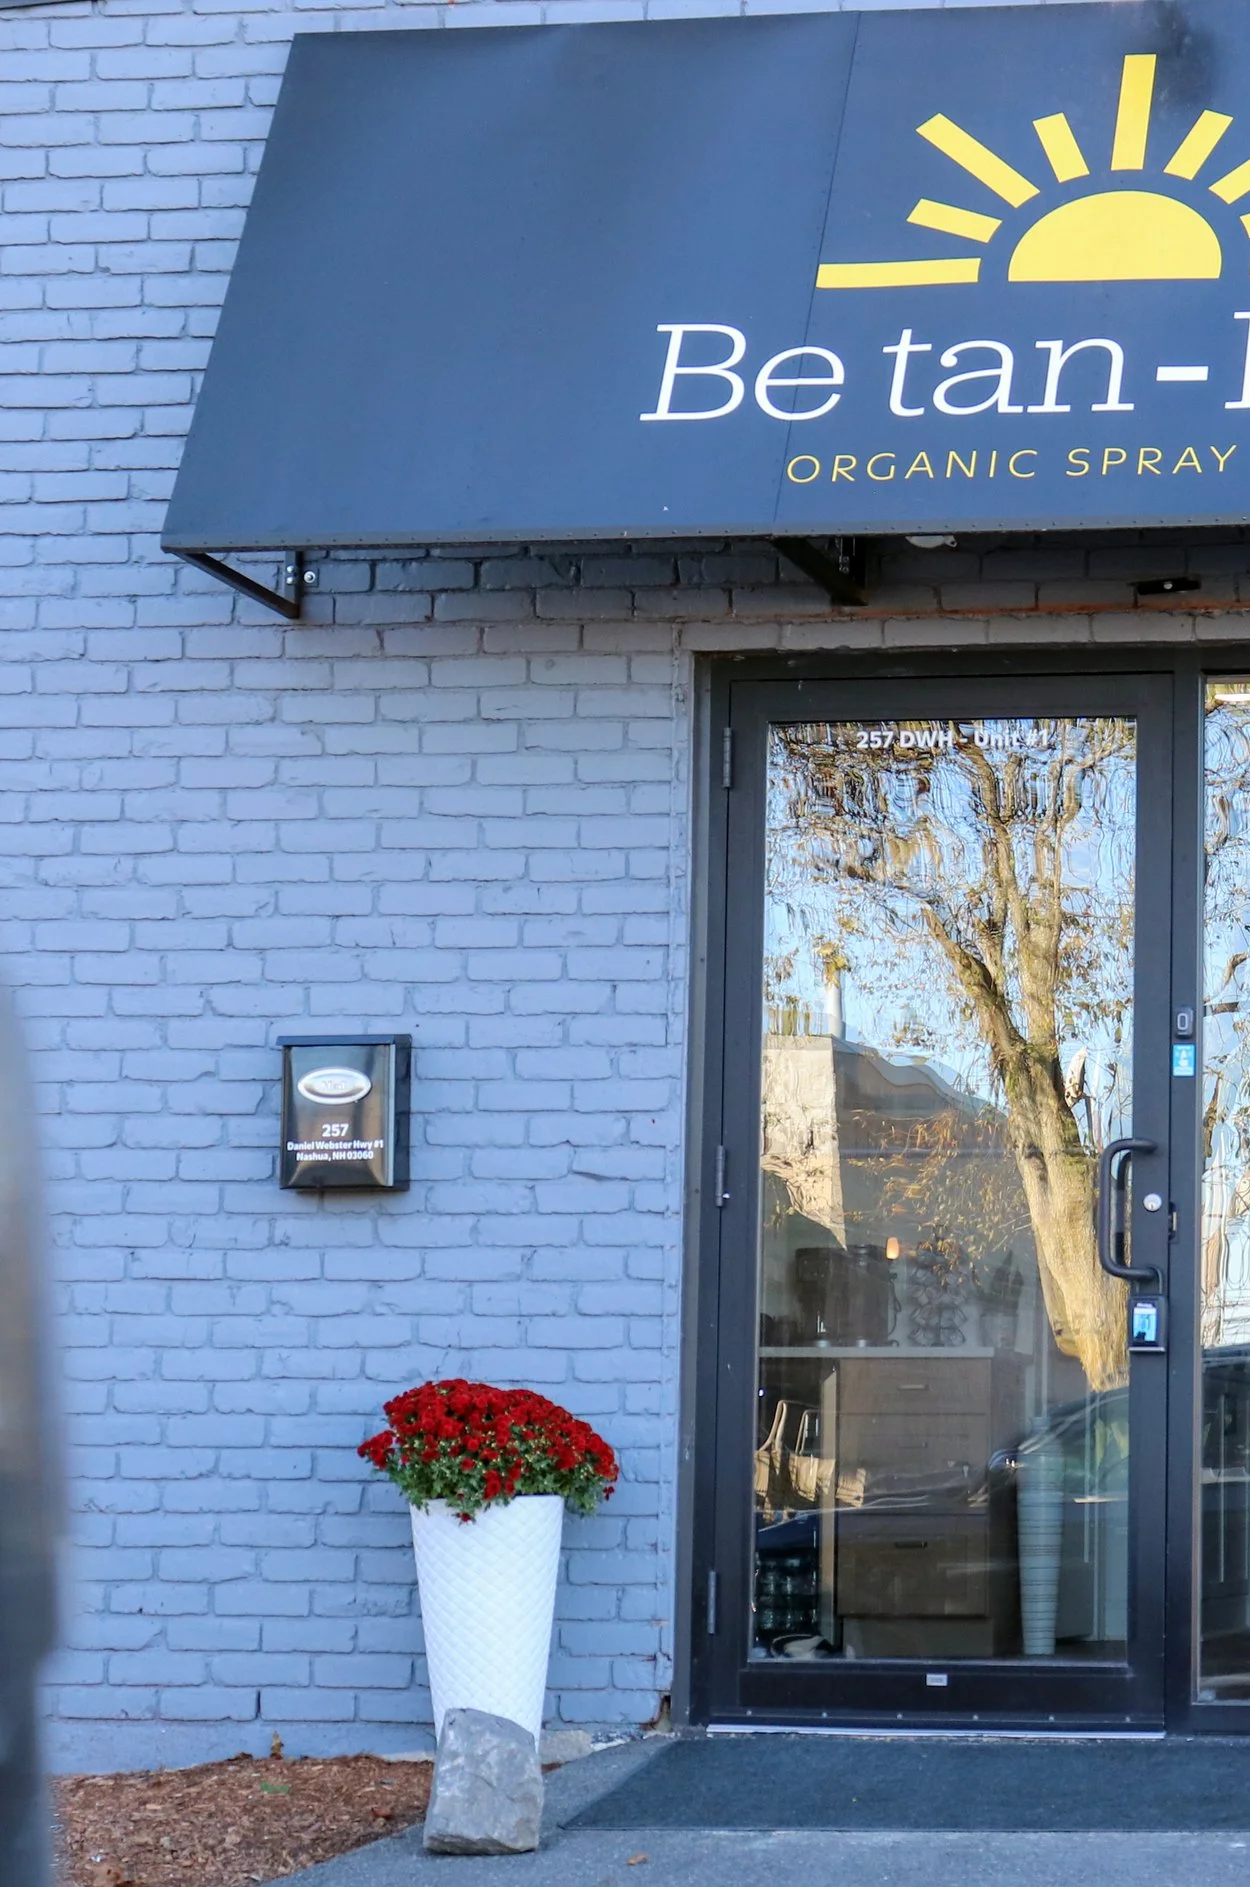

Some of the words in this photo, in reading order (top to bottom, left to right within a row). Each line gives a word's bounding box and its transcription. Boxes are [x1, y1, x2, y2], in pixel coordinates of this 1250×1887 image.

[639, 323, 845, 422] Be
[786, 449, 1037, 484] ORGANIC
[1066, 445, 1236, 478] SPRAY
[856, 731, 894, 749] 257
[900, 731, 953, 749] DWH
[974, 729, 1020, 747] Unit
[1026, 730, 1050, 746] #1
[321, 1122, 349, 1138] 257
[287, 1141, 314, 1151] Daniel
[315, 1140, 353, 1150] Webster
[353, 1140, 373, 1150] Hwy
[373, 1139, 384, 1149] #1
[296, 1152, 332, 1162] Nashua,
[332, 1151, 346, 1160] NH
[347, 1150, 375, 1160] 03060
